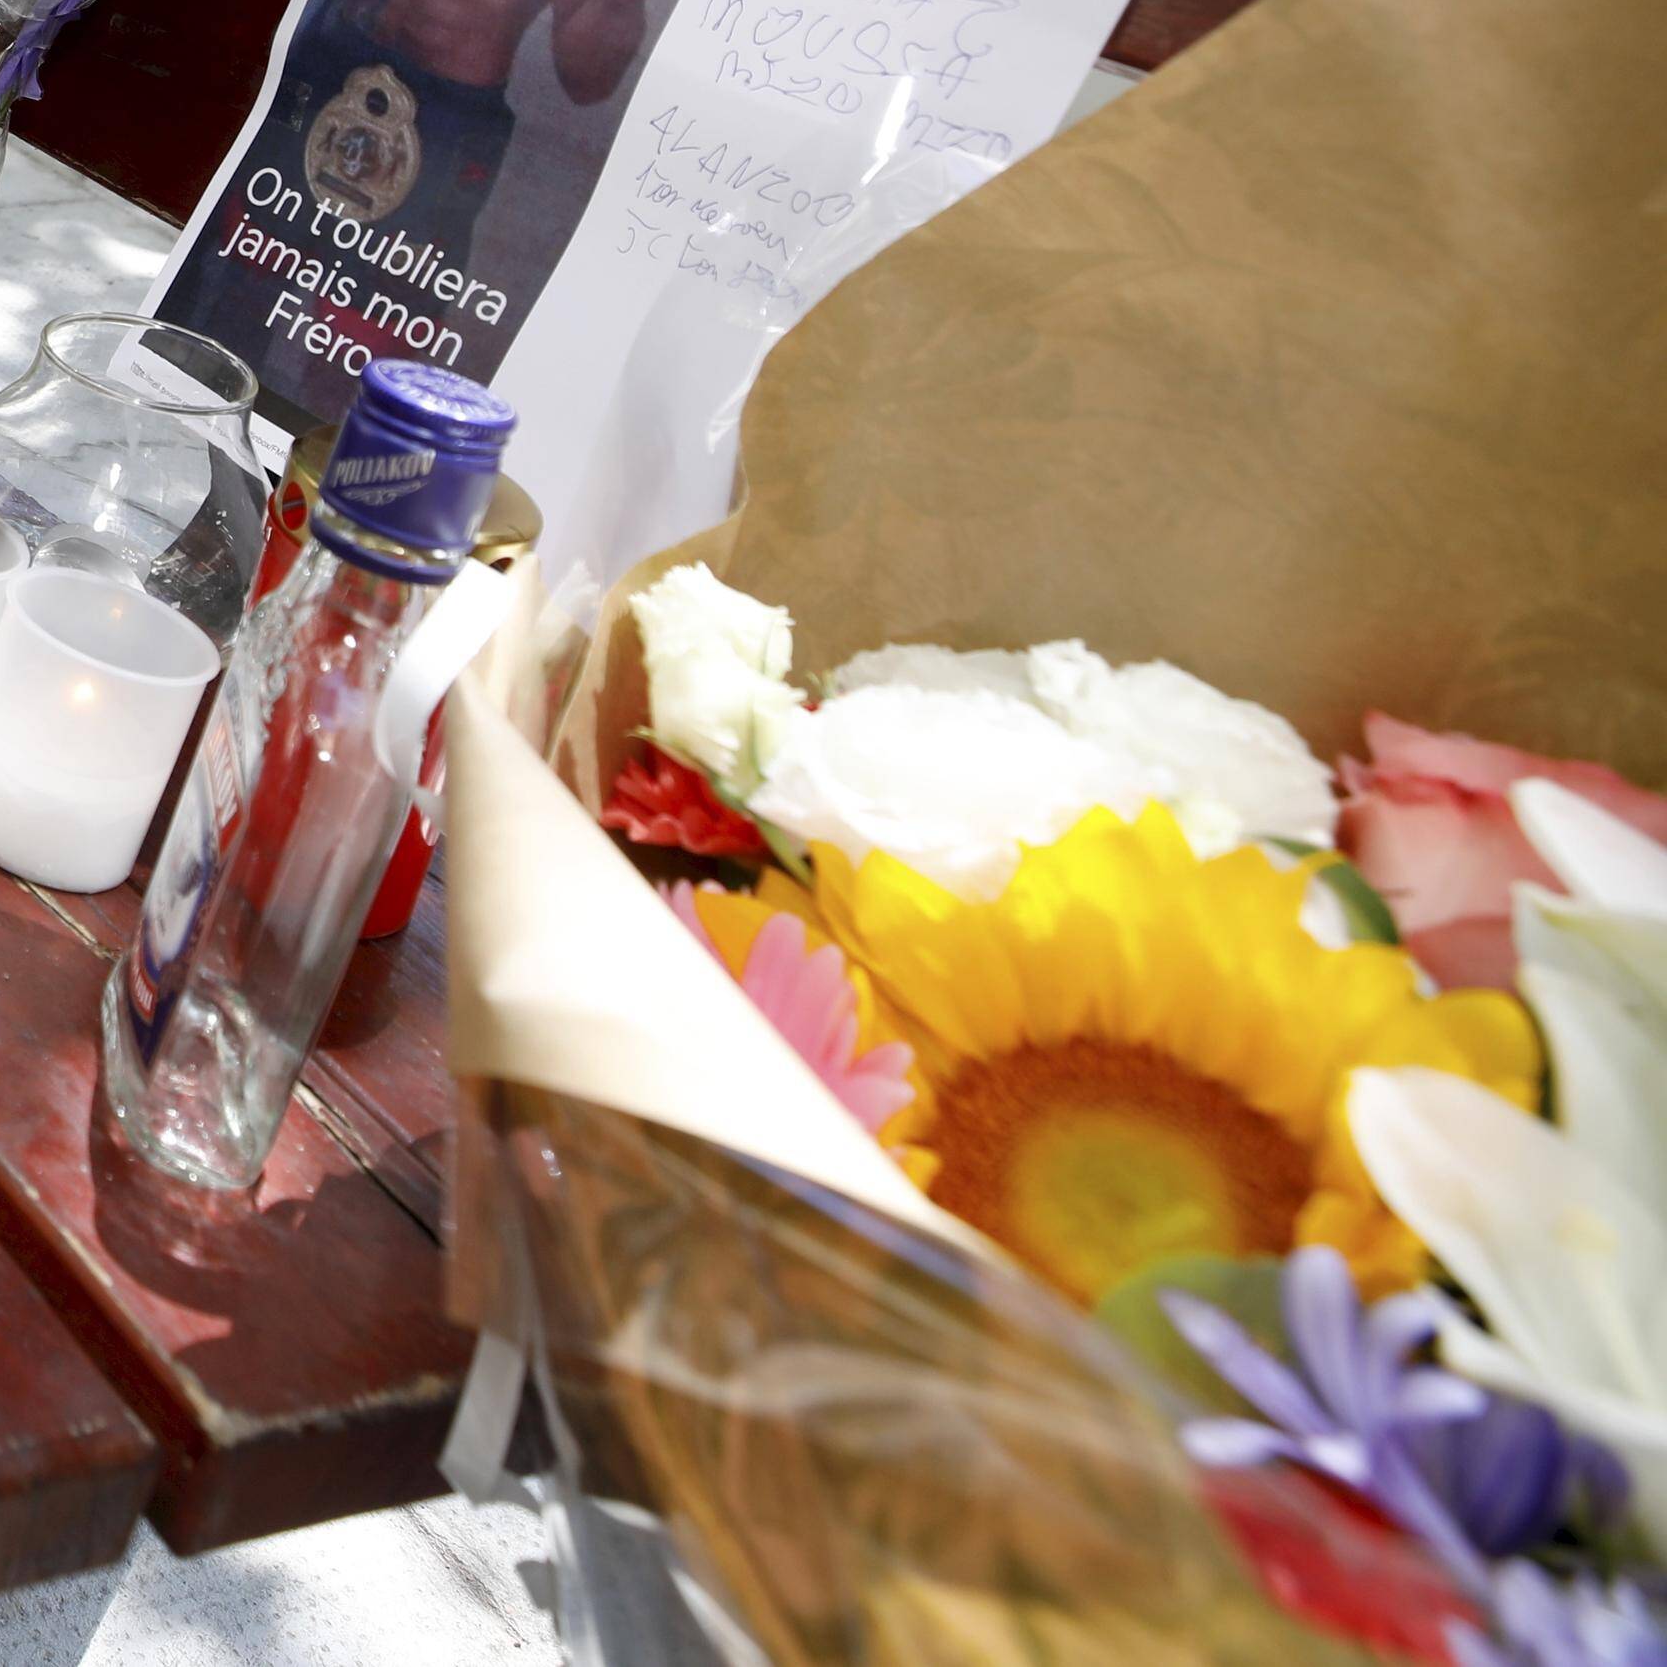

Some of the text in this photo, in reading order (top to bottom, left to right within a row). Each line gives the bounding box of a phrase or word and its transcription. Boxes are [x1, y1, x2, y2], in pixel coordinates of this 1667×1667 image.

[217, 212, 465, 368] jamais mon
[245, 166, 509, 327] On t'oubliera
[264, 289, 373, 379] Fréro
[334, 448, 438, 488] POLIAKOV
